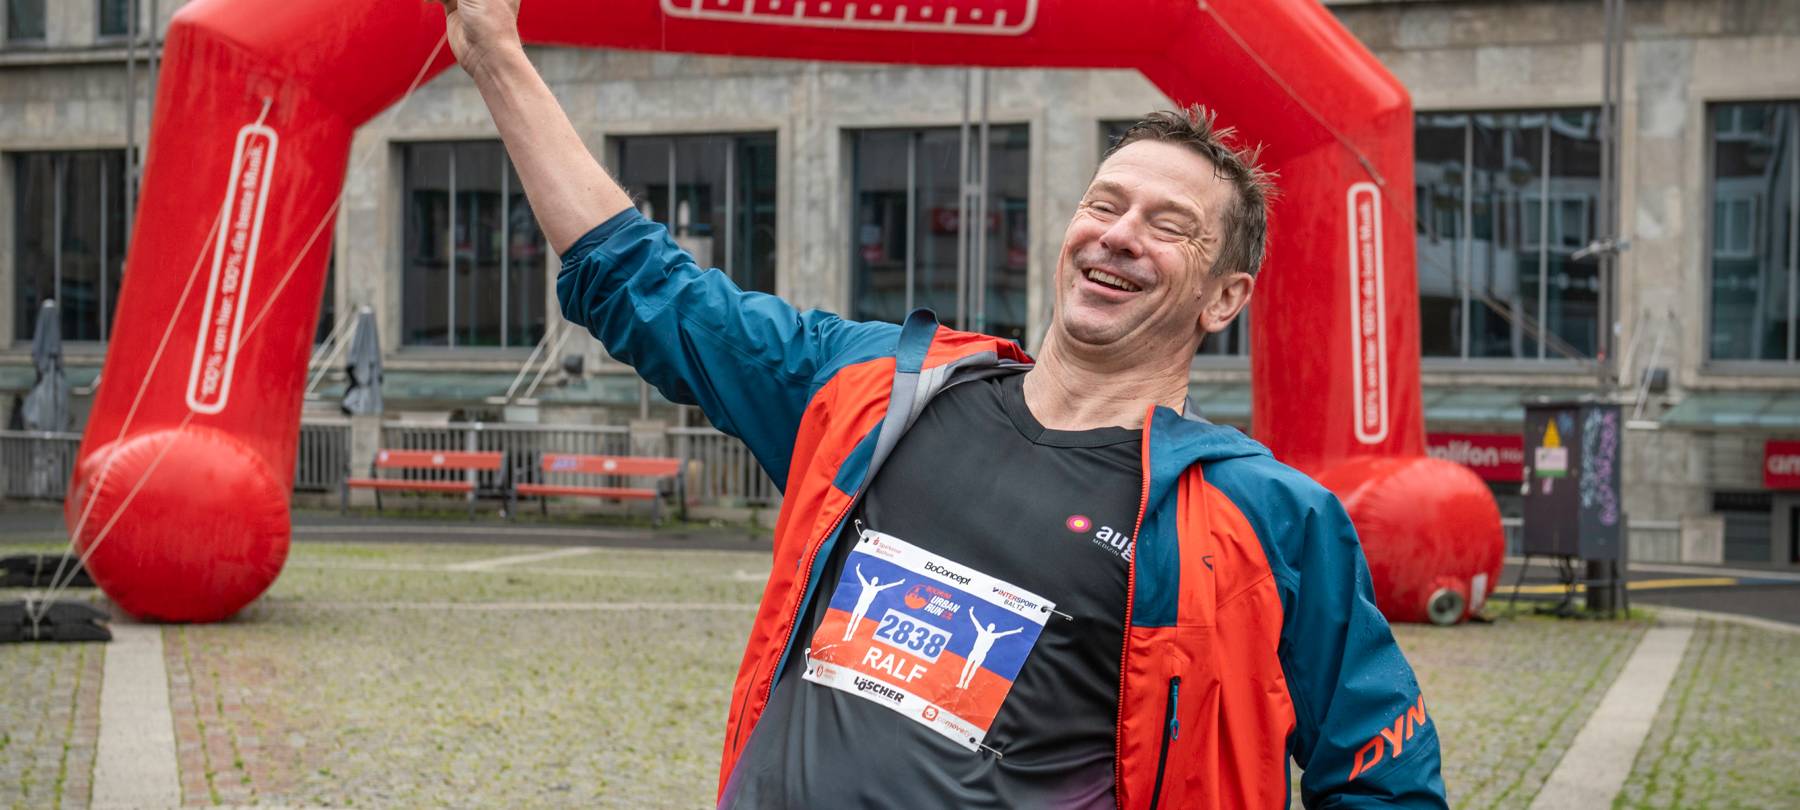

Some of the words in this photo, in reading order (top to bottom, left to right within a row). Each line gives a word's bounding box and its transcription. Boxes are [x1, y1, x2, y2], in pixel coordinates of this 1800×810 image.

[234, 191, 255, 230] beste
[230, 230, 248, 253] die
[221, 253, 243, 293] 100%
[215, 295, 234, 325] hier.
[213, 325, 228, 352] von
[1092, 538, 1120, 556] MEDIZIN
[924, 561, 971, 585] BoConcept
[924, 603, 945, 617] RUN
[930, 595, 961, 613] URBAN
[997, 589, 1038, 610] INTERSPORT
[1003, 599, 1025, 612] BALTZ
[875, 614, 947, 658] 2838
[861, 645, 928, 684] RALF
[853, 676, 905, 703] LÖSCHER
[1347, 693, 1426, 782] DYN
